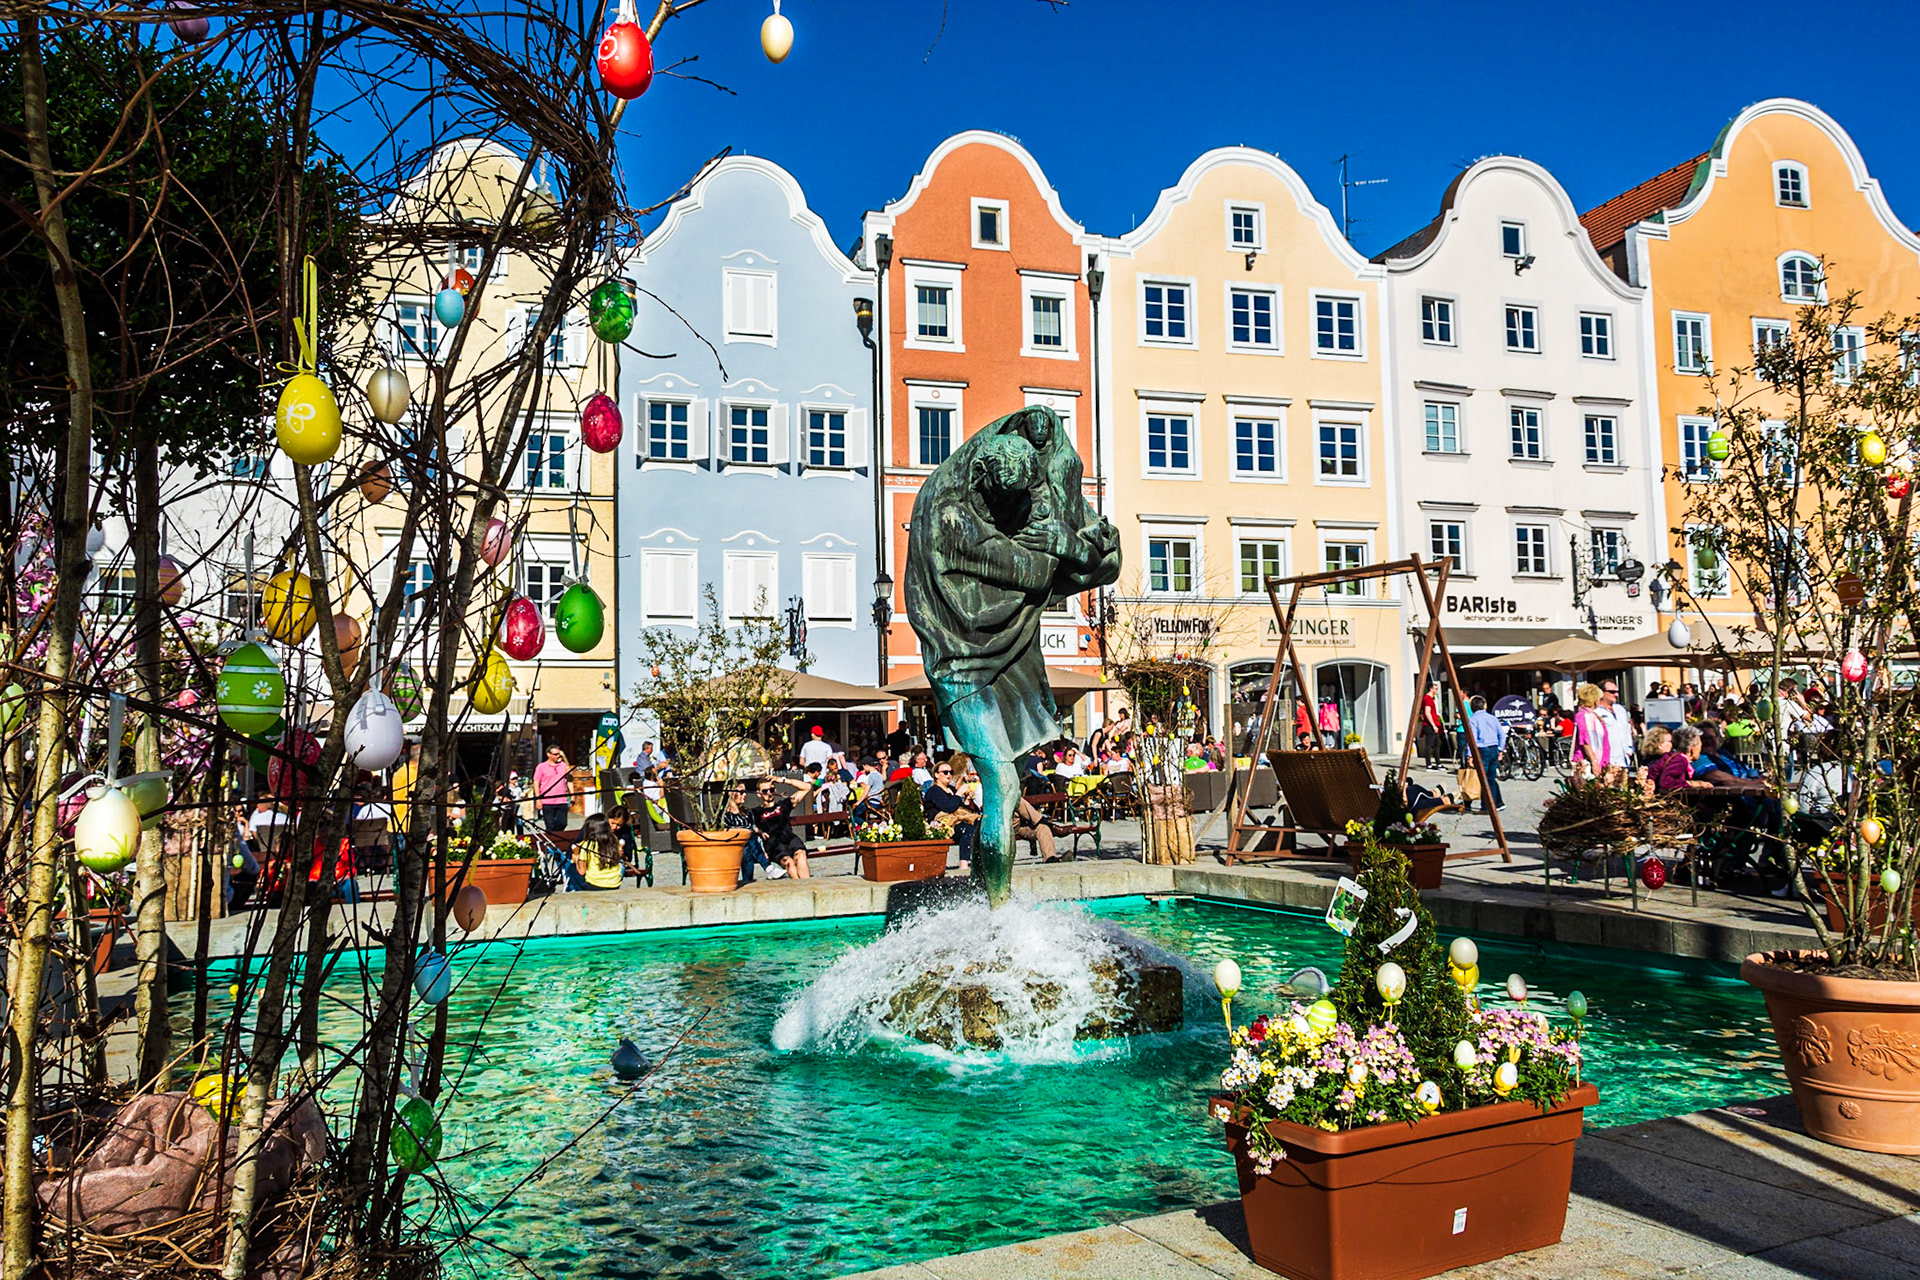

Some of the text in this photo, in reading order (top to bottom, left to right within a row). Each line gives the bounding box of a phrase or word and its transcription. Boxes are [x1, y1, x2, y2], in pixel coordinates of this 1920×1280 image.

[1446, 595, 1516, 613] BARista
[1267, 619, 1349, 635] AZINGER
[1040, 634, 1066, 649] UCK
